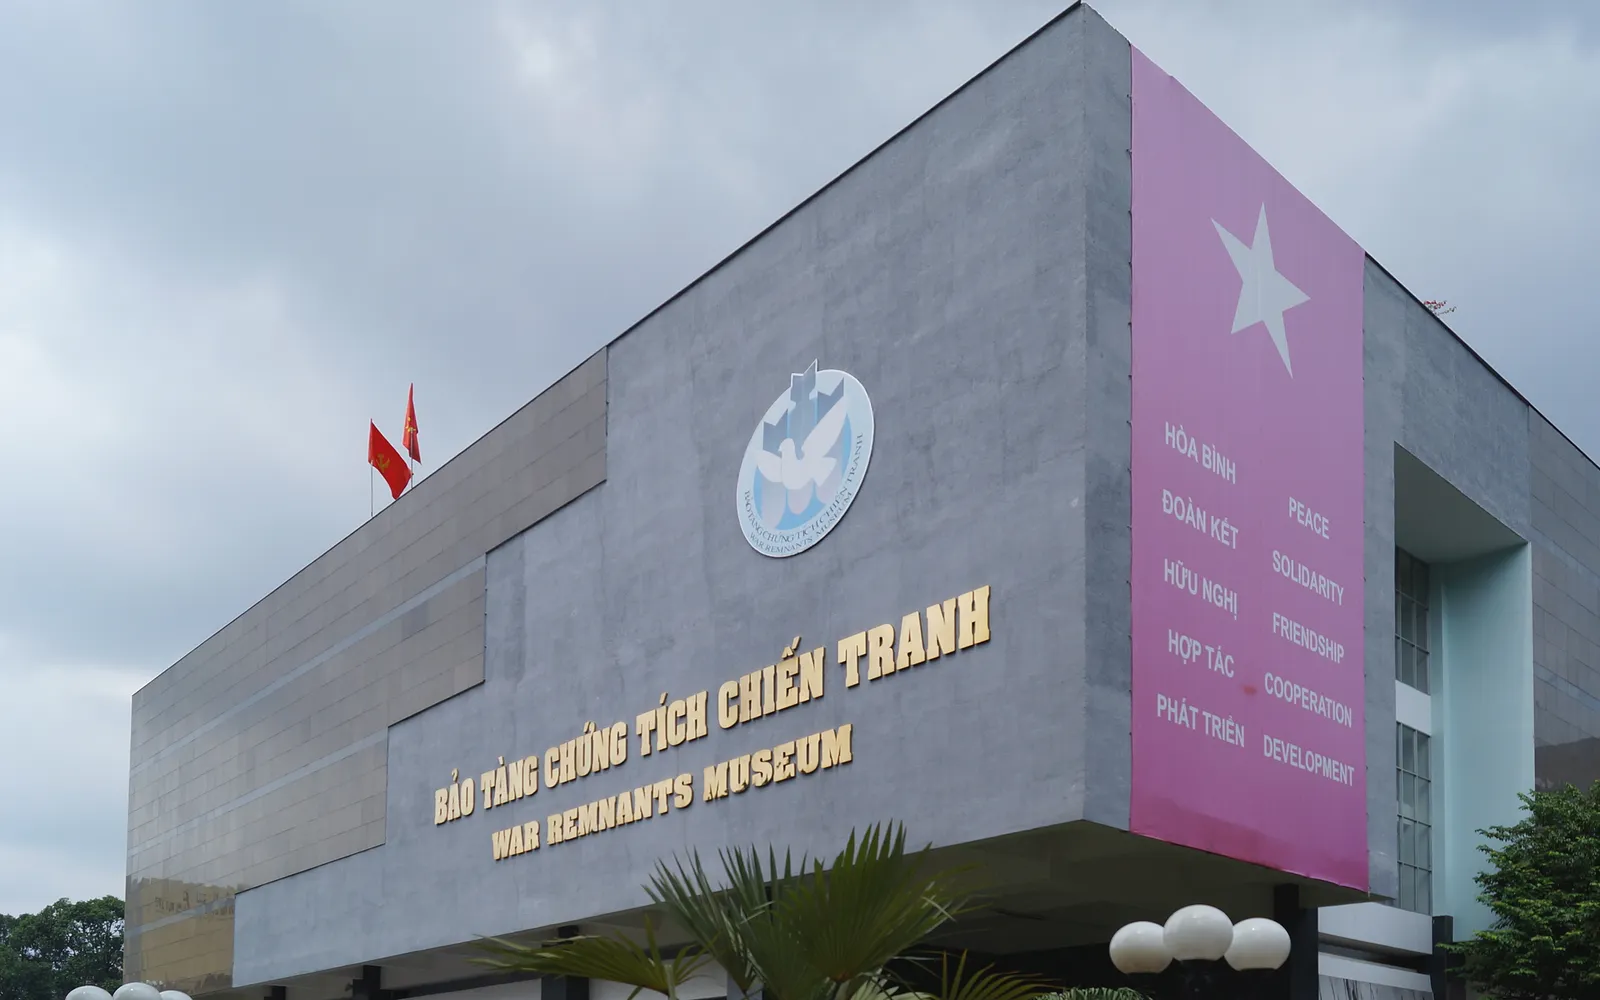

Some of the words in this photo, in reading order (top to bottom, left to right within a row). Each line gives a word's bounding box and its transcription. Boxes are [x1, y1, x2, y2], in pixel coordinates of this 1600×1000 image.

[846, 433, 864, 484] TRANH
[1165, 421, 1199, 463] HÒA
[1202, 444, 1236, 485] BÌNH
[749, 532, 765, 549] WAR
[764, 535, 814, 554] REMNANTS
[815, 491, 853, 538] MUSEUM
[1162, 488, 1206, 533] ĐOÀN
[1210, 516, 1239, 549] KẾT
[1288, 496, 1330, 540] PEACE
[1164, 558, 1198, 595] HỮU
[1202, 577, 1238, 621] NGHỊ
[1272, 549, 1344, 606] SOLIDARITY
[1168, 628, 1202, 665] HỢP
[1205, 645, 1235, 678] TÁC
[1272, 612, 1345, 664] FRIENDSHIP
[434, 768, 475, 825] BẢO
[480, 756, 539, 810] TÀNG
[544, 721, 628, 789] CHỨNG
[635, 692, 708, 757] TÍCH
[717, 635, 826, 730] CHIẾN
[837, 584, 992, 688] TRANH
[1157, 693, 1199, 730] PHÁT
[1264, 672, 1352, 728] COOPERATION
[1263, 734, 1355, 787] DEVELOPMENT
[491, 819, 541, 862] WAR
[547, 773, 694, 845] REMNANTS
[703, 723, 853, 802] MUSEUM
